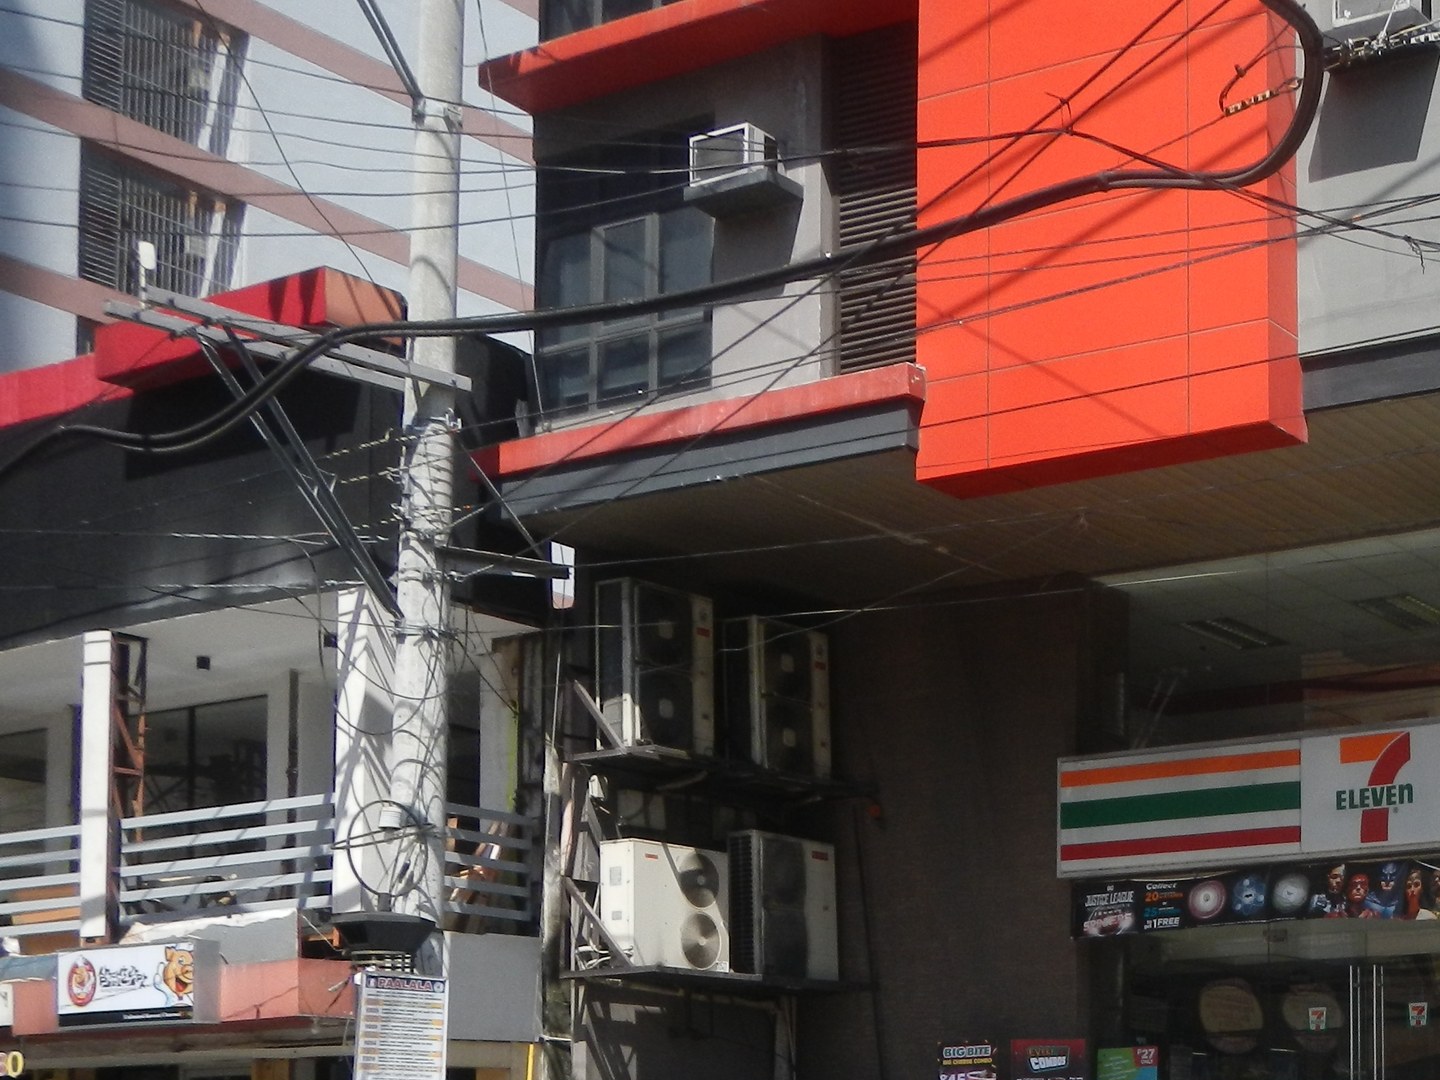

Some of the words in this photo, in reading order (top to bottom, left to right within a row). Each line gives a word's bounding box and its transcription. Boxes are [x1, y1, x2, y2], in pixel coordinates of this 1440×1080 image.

[1340, 731, 1411, 843] 7
[1085, 894, 1109, 907] JUSTICE
[1110, 891, 1134, 904] LEAGUE
[1158, 917, 1180, 926] FREE
[378, 978, 433, 991] PAALALA
[944, 1047, 965, 1056] BIG
[967, 1046, 990, 1056] BITE
